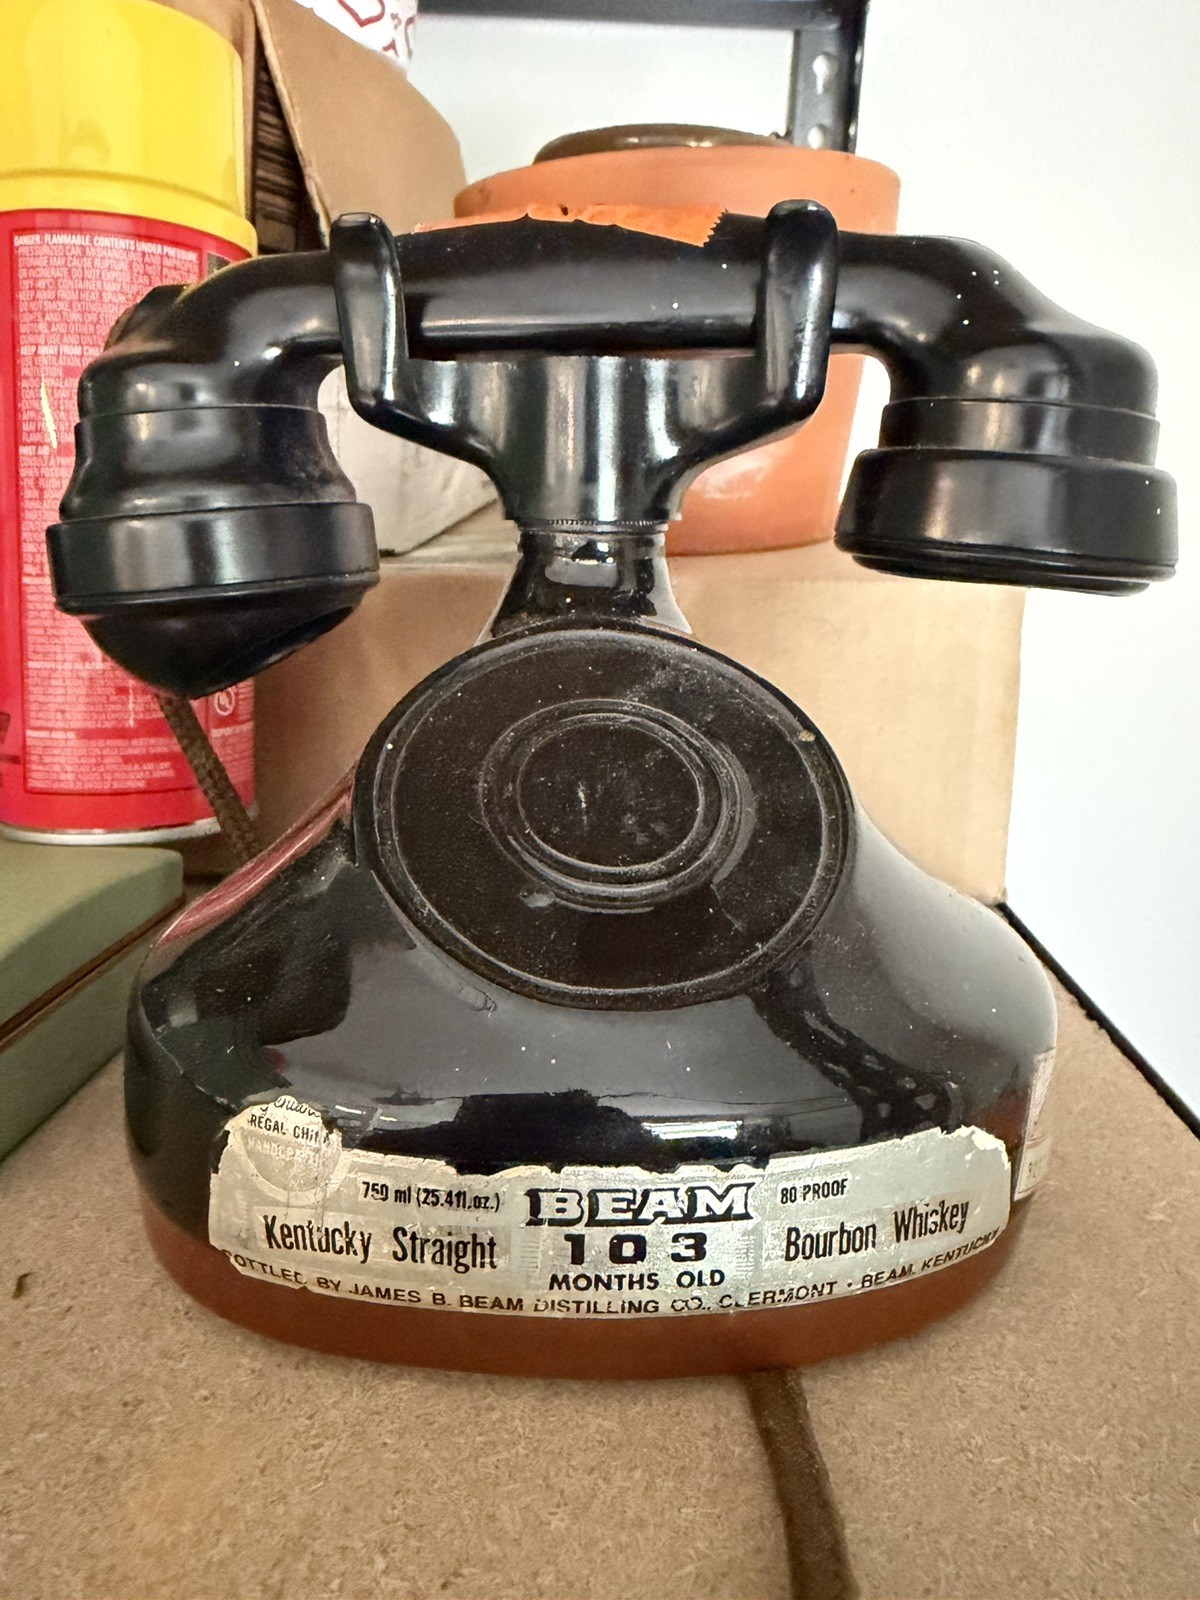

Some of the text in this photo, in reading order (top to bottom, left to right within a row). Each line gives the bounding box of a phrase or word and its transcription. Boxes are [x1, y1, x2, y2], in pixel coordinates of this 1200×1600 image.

[250, 1114, 287, 1136] REGAL
[362, 1181, 388, 1201] 750
[394, 1185, 411, 1204] ml
[524, 1182, 756, 1227] BEAM
[780, 1178, 848, 1204] 80 PROOF
[263, 1215, 498, 1274] Kentucky Straight
[784, 1200, 970, 1262] Bourbon Whiskey
[221, 1249, 307, 1285] OTTLED
[316, 1277, 341, 1292] BY
[349, 1283, 421, 1303] JAMES
[432, 1293, 451, 1306] B.
[459, 1295, 524, 1312] BEAM
[533, 1299, 659, 1315] DISTILLING
[921, 1226, 1000, 1271] KENTUCKY
[549, 1269, 725, 1292] MONTHS OLD
